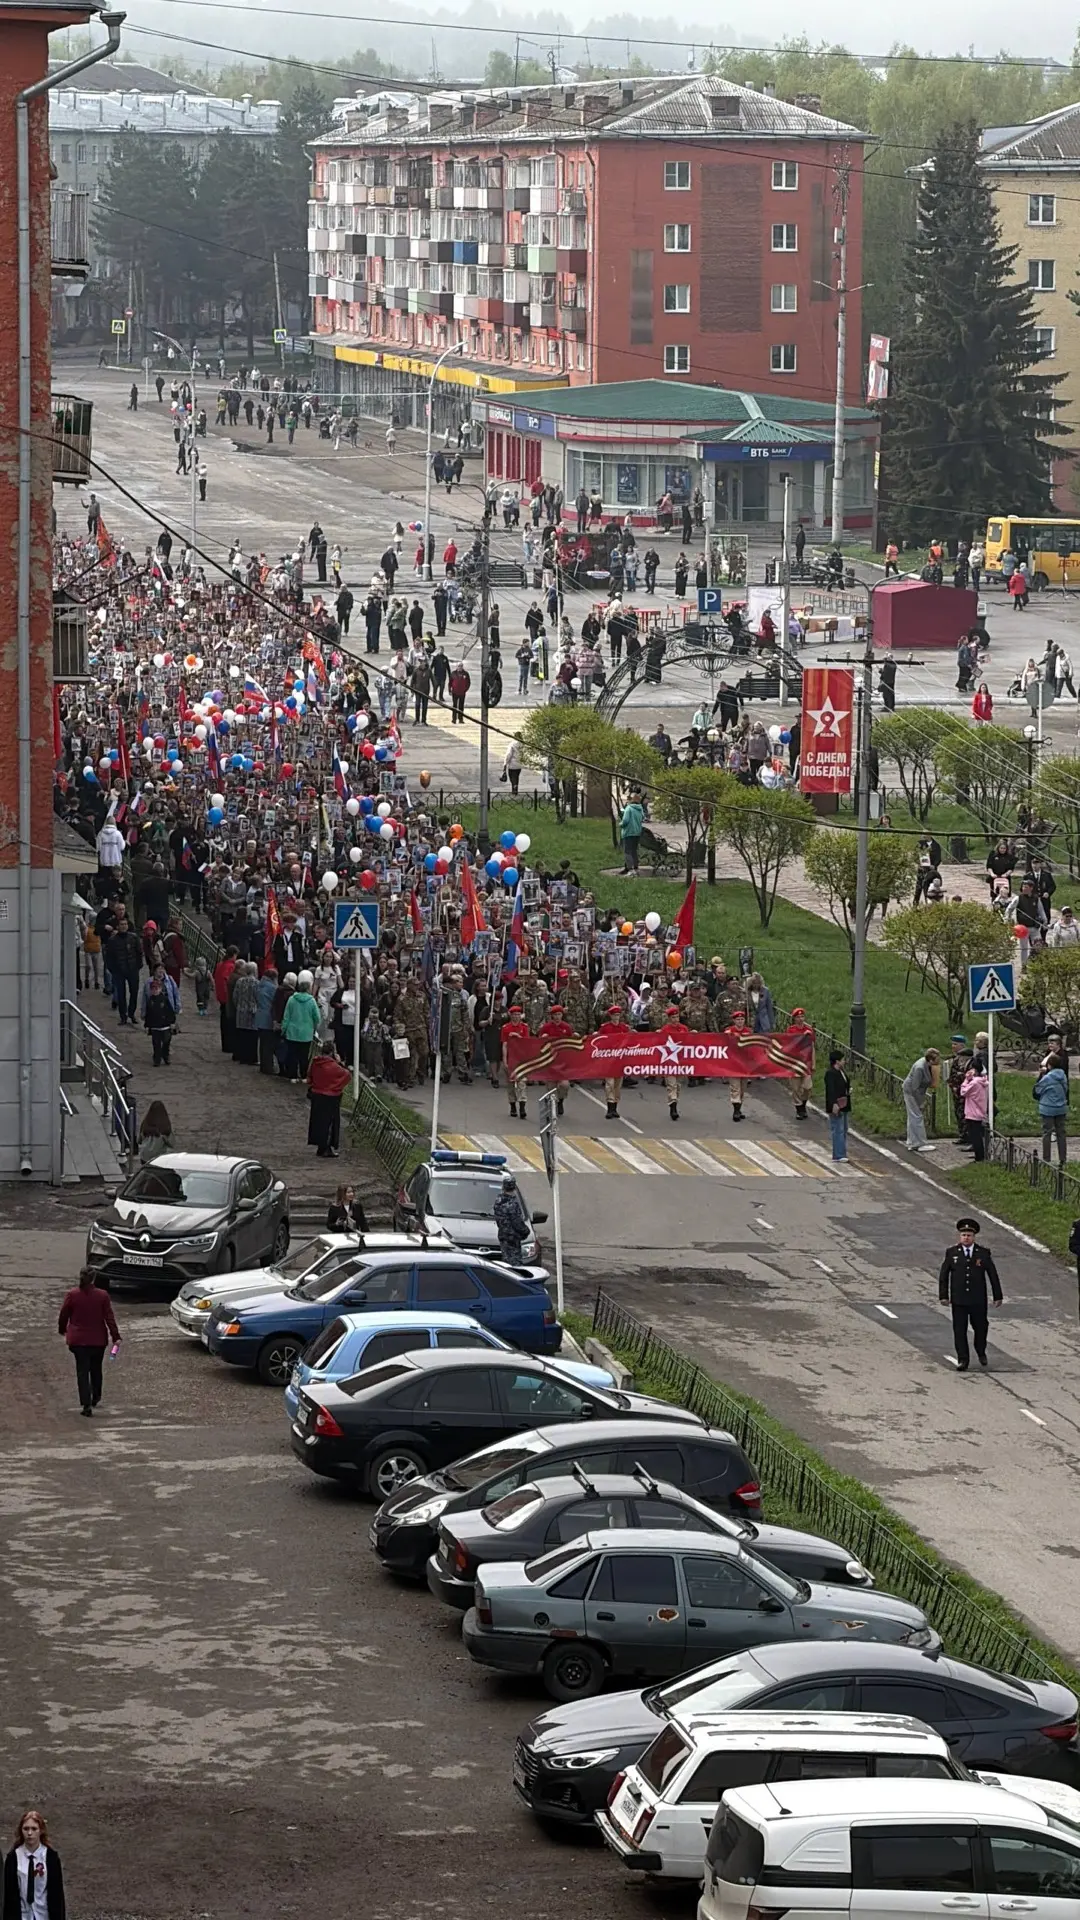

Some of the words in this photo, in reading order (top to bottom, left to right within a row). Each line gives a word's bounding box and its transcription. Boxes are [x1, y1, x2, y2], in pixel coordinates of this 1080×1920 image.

[750, 448, 769, 457] ВТБ
[704, 591, 717, 610] P
[820, 711, 835, 733] 9
[806, 752, 814, 763] С
[816, 752, 847, 764] ДНЕМ
[802, 765, 850, 778] ПОБЕДЫ!
[683, 1046, 729, 1059] ПОЛК
[623, 1065, 695, 1075] ОСИННИКИ
